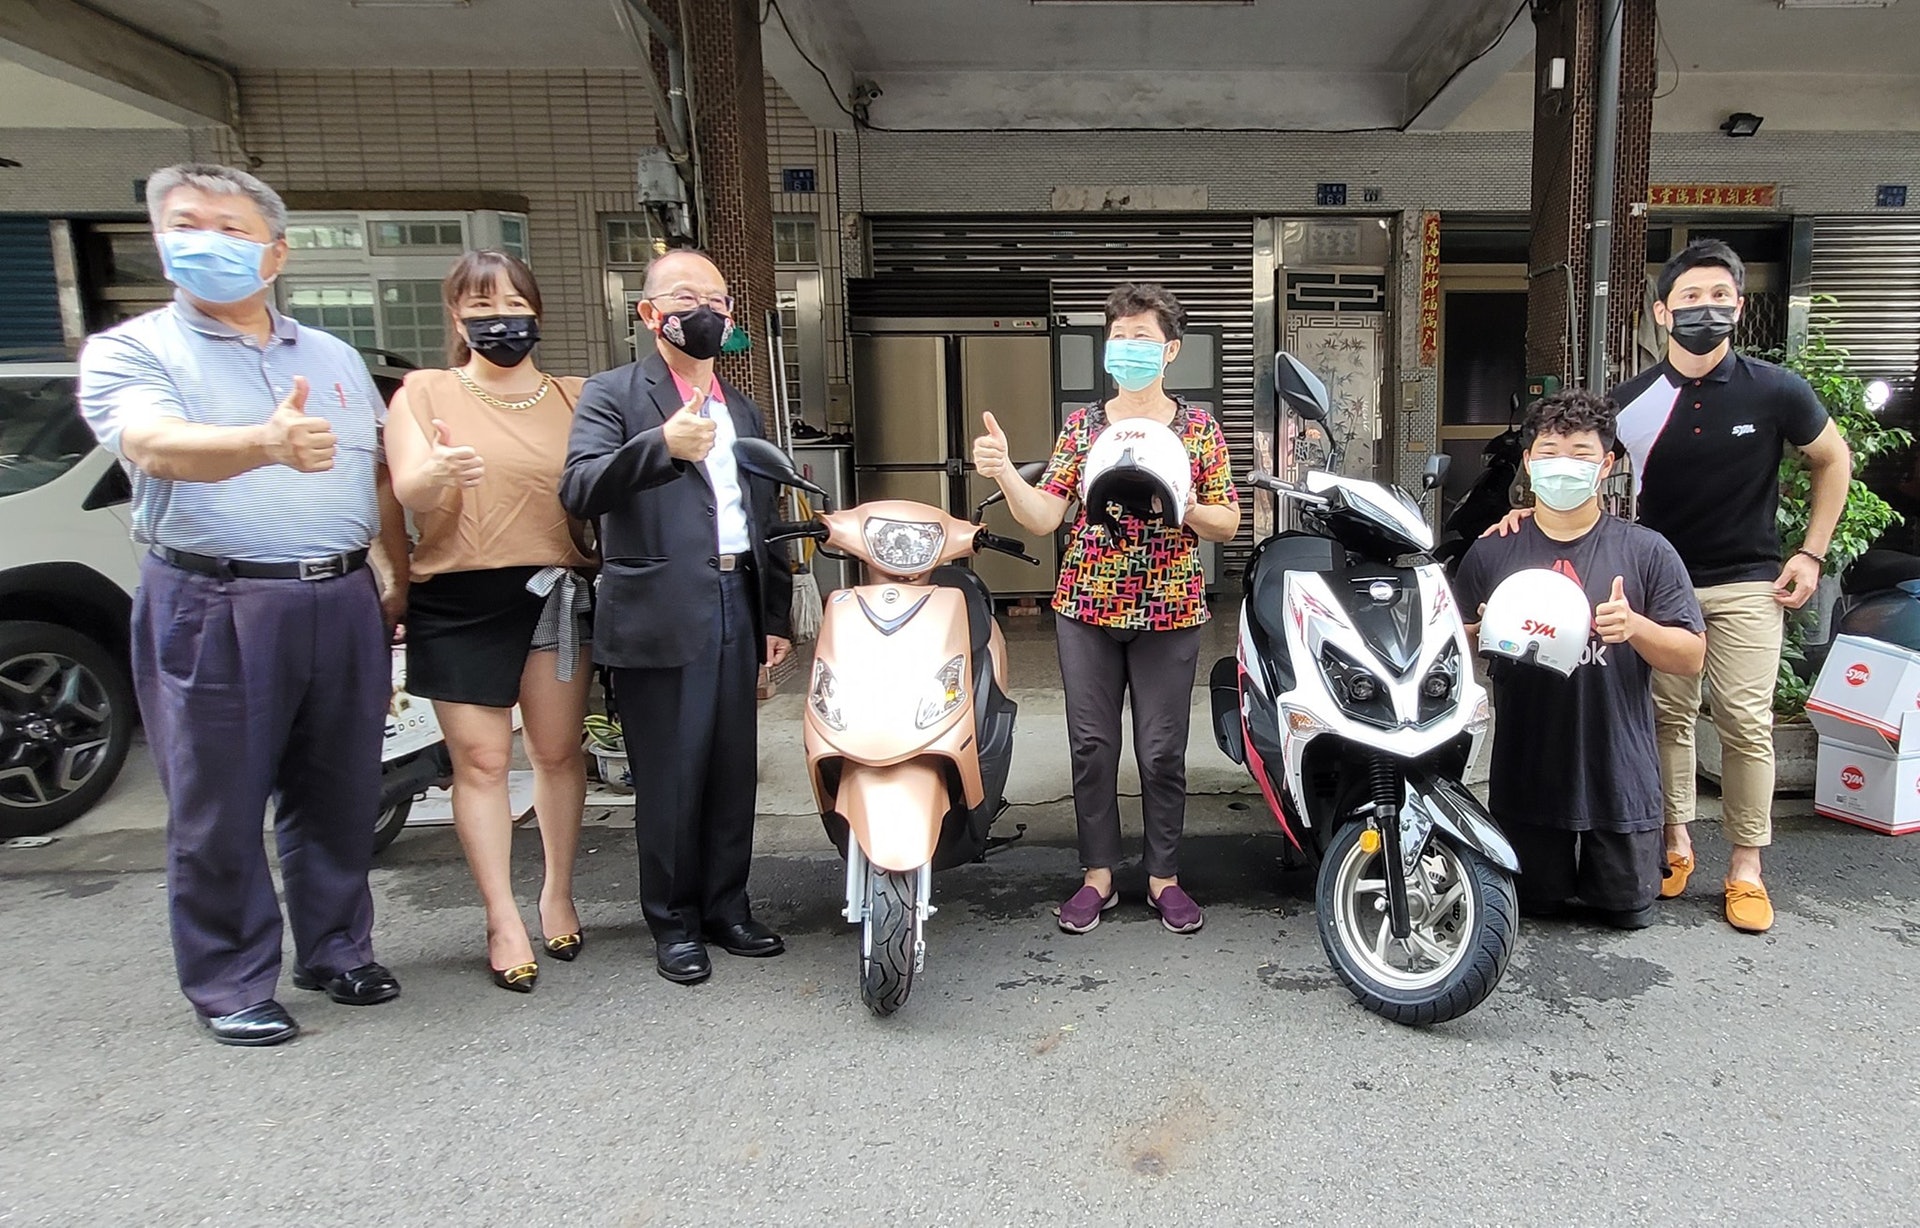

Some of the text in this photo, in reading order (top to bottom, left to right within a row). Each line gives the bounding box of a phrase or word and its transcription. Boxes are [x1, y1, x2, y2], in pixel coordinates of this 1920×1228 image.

[1326, 193, 1344, 205] 63
[1113, 430, 1146, 441] SYM
[1521, 619, 1556, 639] SYM
[1578, 640, 1607, 666] ok
[1846, 668, 1869, 682] SYM
[1841, 772, 1864, 786] SYM
